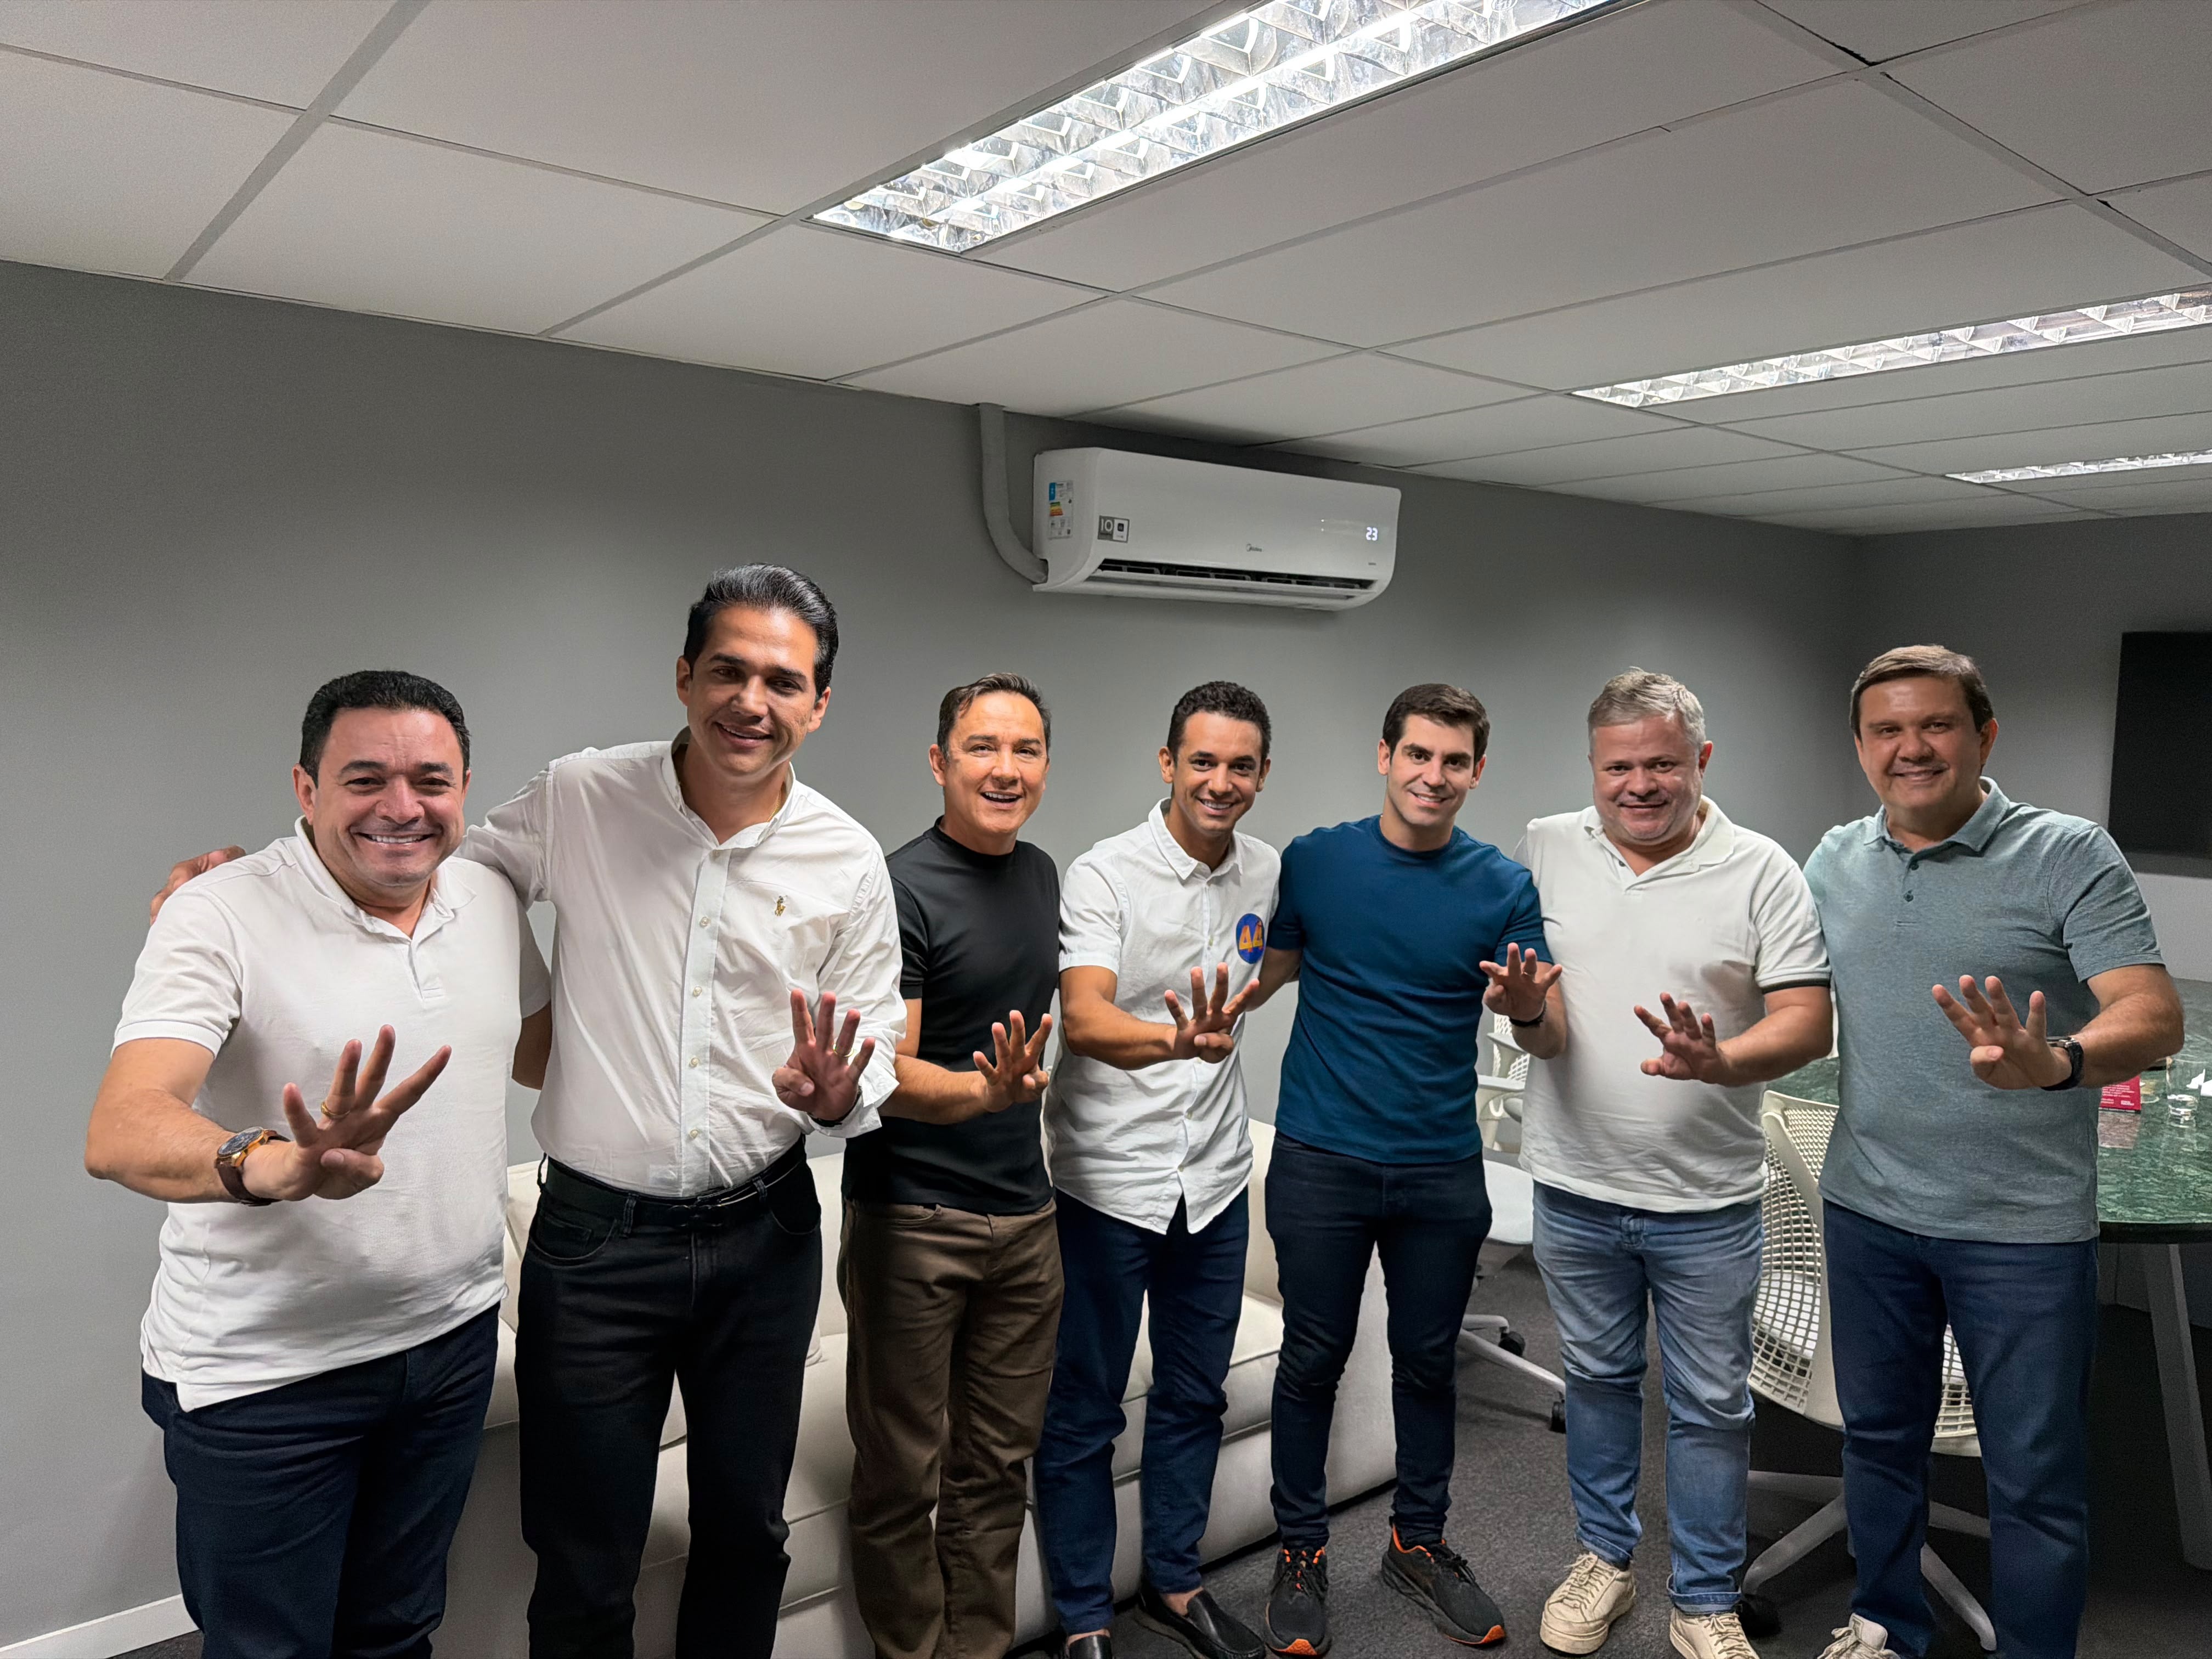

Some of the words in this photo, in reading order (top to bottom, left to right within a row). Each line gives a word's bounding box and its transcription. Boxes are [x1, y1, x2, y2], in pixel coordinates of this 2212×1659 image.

[1101, 518, 1113, 532] 10
[1365, 527, 1378, 541] 23
[1239, 921, 1263, 953] 44
